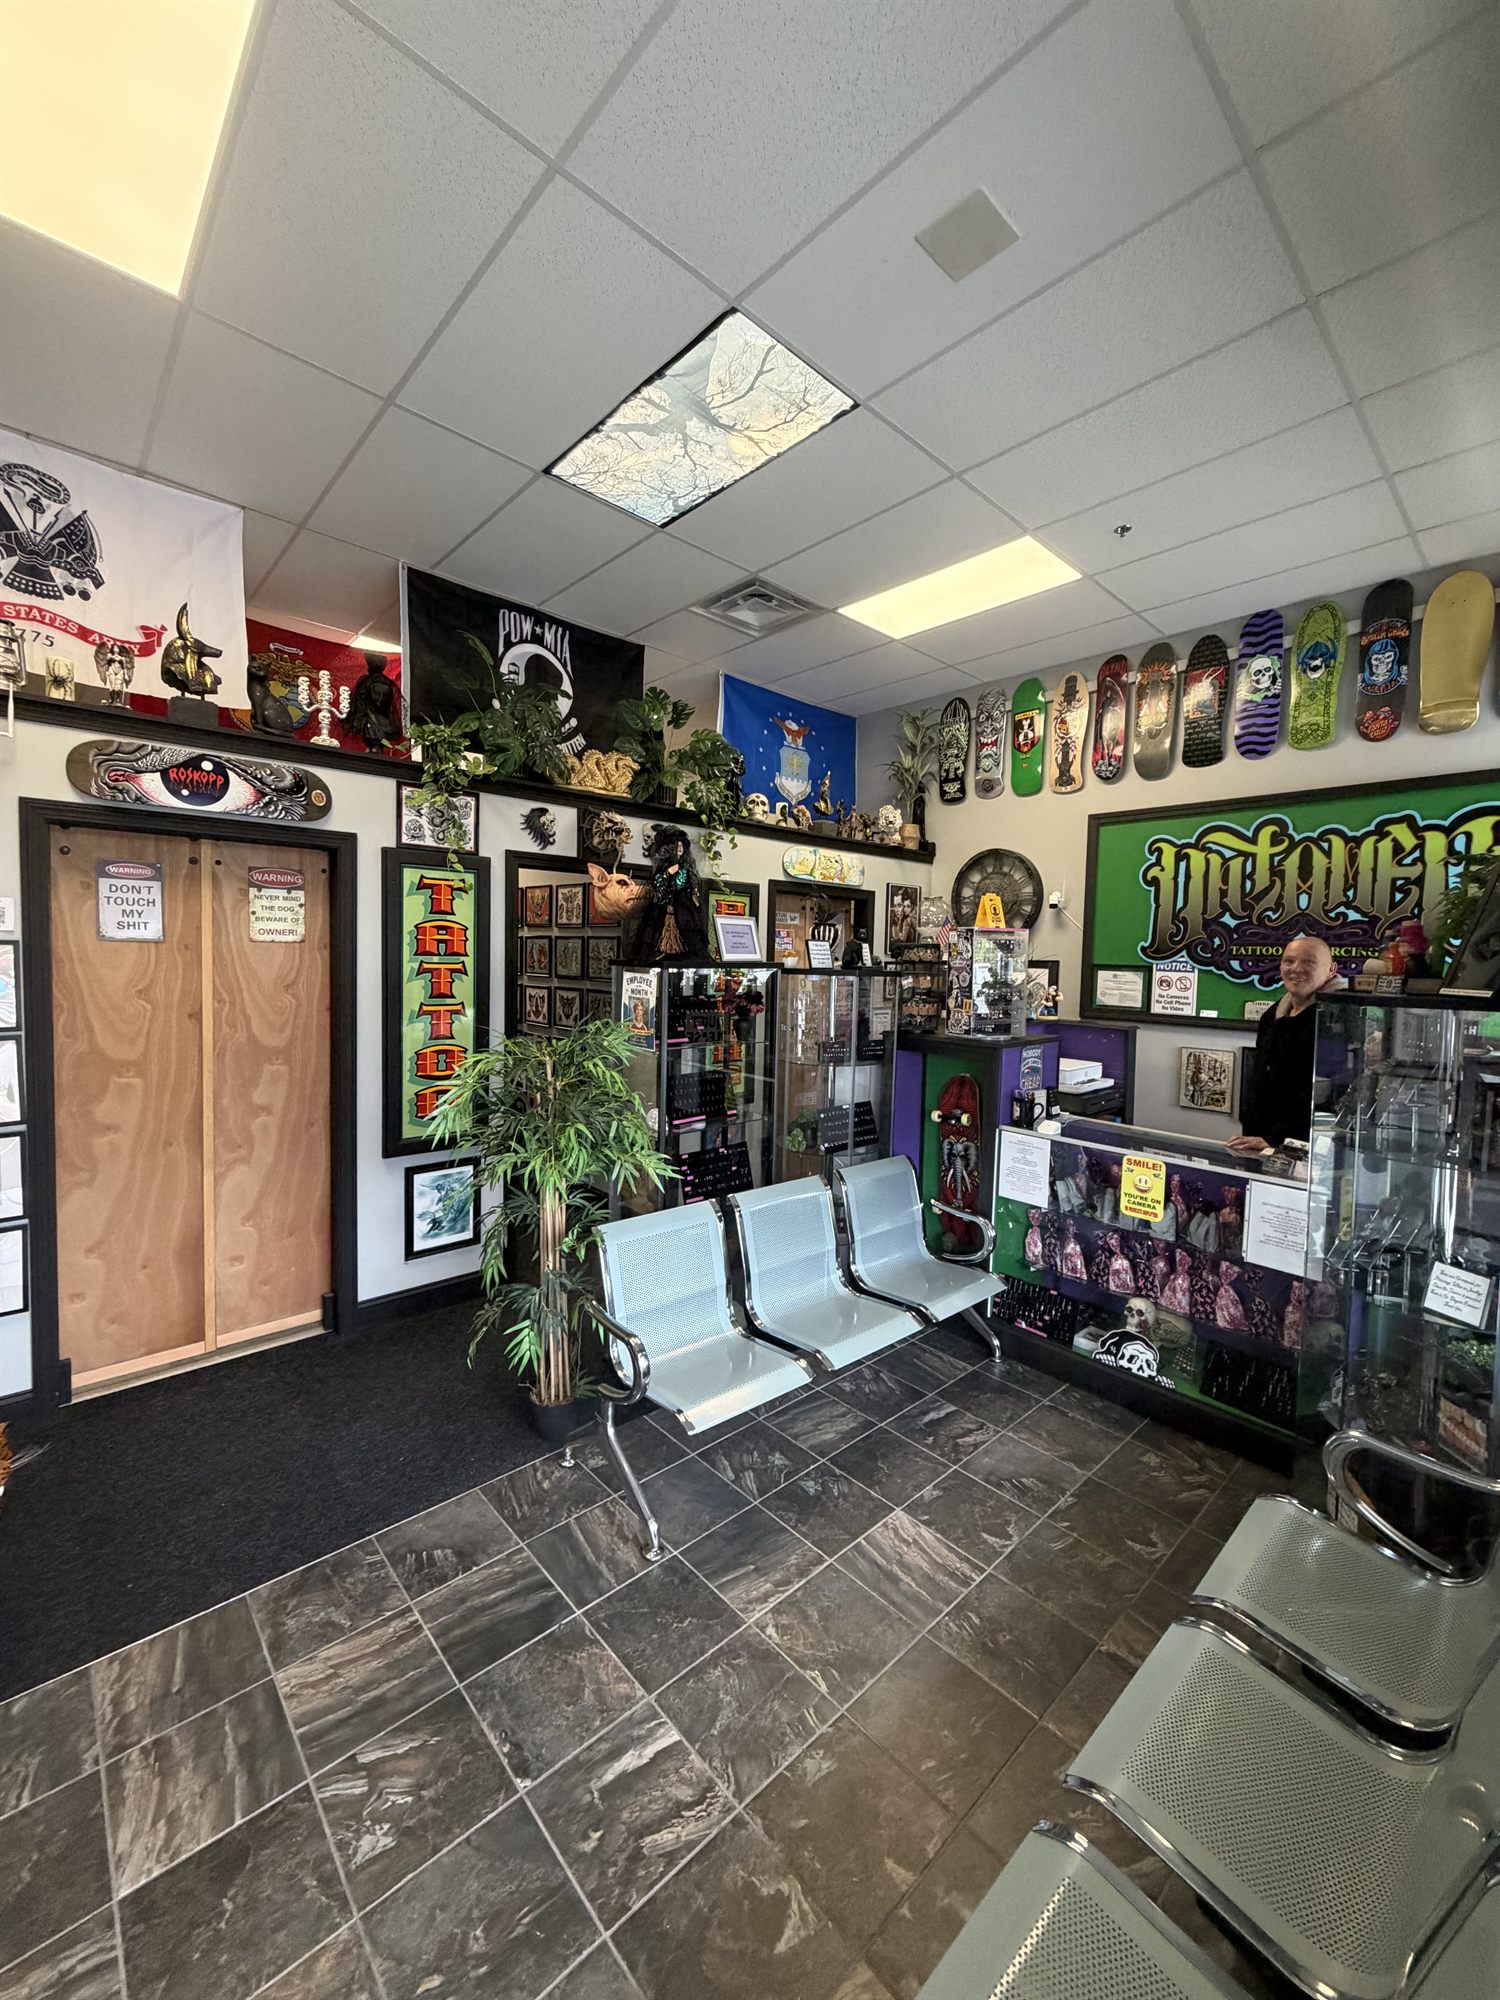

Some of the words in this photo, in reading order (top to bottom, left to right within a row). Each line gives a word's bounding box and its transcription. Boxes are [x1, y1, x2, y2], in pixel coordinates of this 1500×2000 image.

[3, 604, 78, 634] STATES
[88, 632, 141, 656] ARY
[14, 628, 56, 648] 775
[498, 608, 534, 658] POW
[544, 620, 574, 680] MIA
[169, 766, 225, 786] ROSKOPP
[110, 866, 152, 876] WARNING
[252, 872, 302, 884] WARNING
[108, 884, 154, 894] DON'T
[104, 896, 156, 907] TOUCH
[122, 909, 144, 918] MY
[116, 920, 150, 930] SHIT
[258, 928, 298, 937] OWNER!
[1230, 946, 1282, 957] TATTOO
[1332, 946, 1380, 958] RCING
[1157, 962, 1193, 972] NOTICE
[626, 976, 652, 988] EMPLOYEE
[630, 988, 648, 996] MONTH
[413, 874, 469, 1122] TATTOO
[1126, 1158, 1162, 1172] SMILE!
[1124, 1192, 1148, 1202] YOU'RE
[1127, 1200, 1156, 1210] CAMERA
